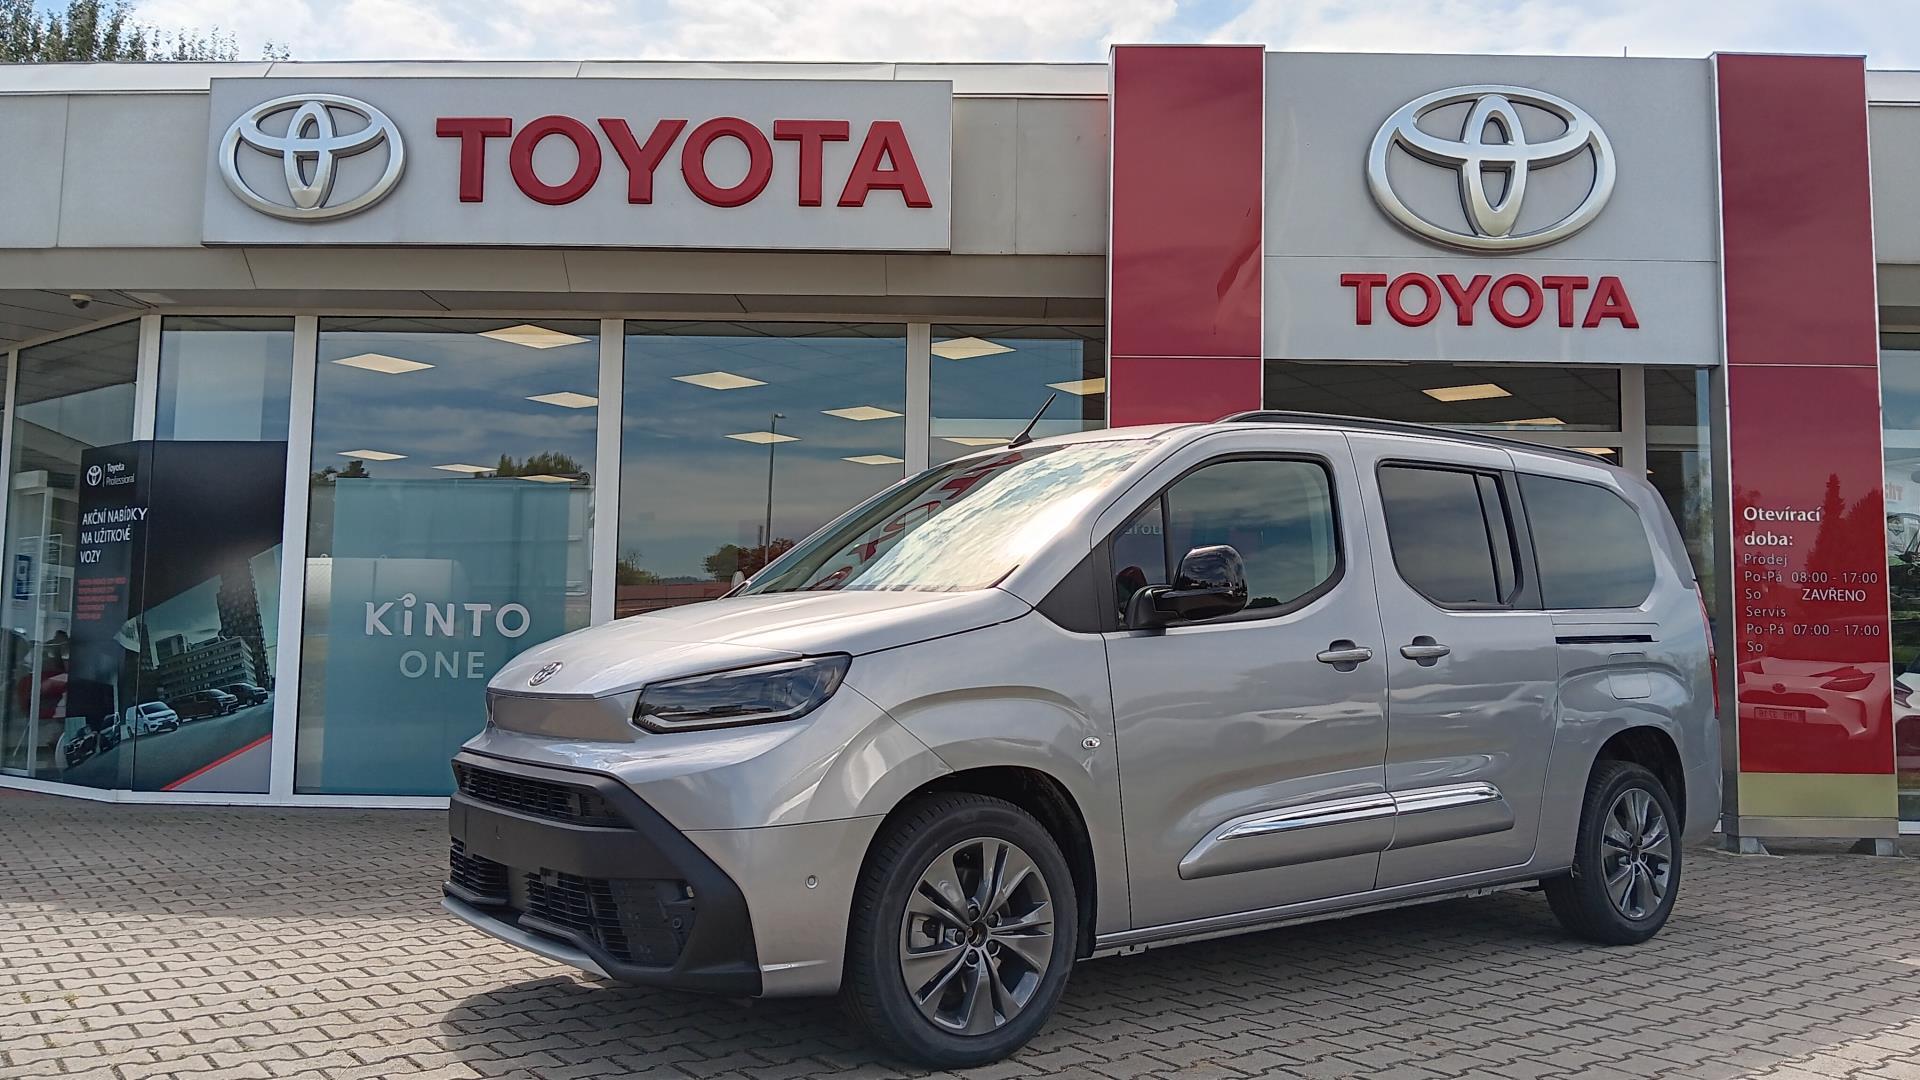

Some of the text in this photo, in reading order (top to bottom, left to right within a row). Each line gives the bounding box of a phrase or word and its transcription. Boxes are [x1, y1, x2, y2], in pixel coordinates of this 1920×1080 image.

[435, 115, 933, 208] TOYOTA
[1340, 272, 1640, 329] TOYOTA
[107, 463, 125, 474] Toyota
[82, 505, 148, 525] AKČNÍ NABÍDKY
[1743, 506, 1822, 522] Otevírací
[81, 524, 131, 544] NA UŽITKOVÉ
[1744, 531, 1793, 546] doba:
[80, 549, 102, 563] VOZY
[1744, 553, 1788, 568] Prodej
[1744, 571, 1782, 582] Po-Pá
[1791, 572, 1828, 583] 08:00
[1842, 572, 1878, 583] 17:00
[1745, 587, 1867, 602] So ZAVŘENO
[1746, 606, 1786, 617] Servis
[1746, 623, 1785, 635] Po-Pá
[1793, 624, 1830, 635] 07:00
[1844, 624, 1880, 636] 17:00
[1747, 641, 1763, 652] So
[400, 650, 485, 679] ONE
